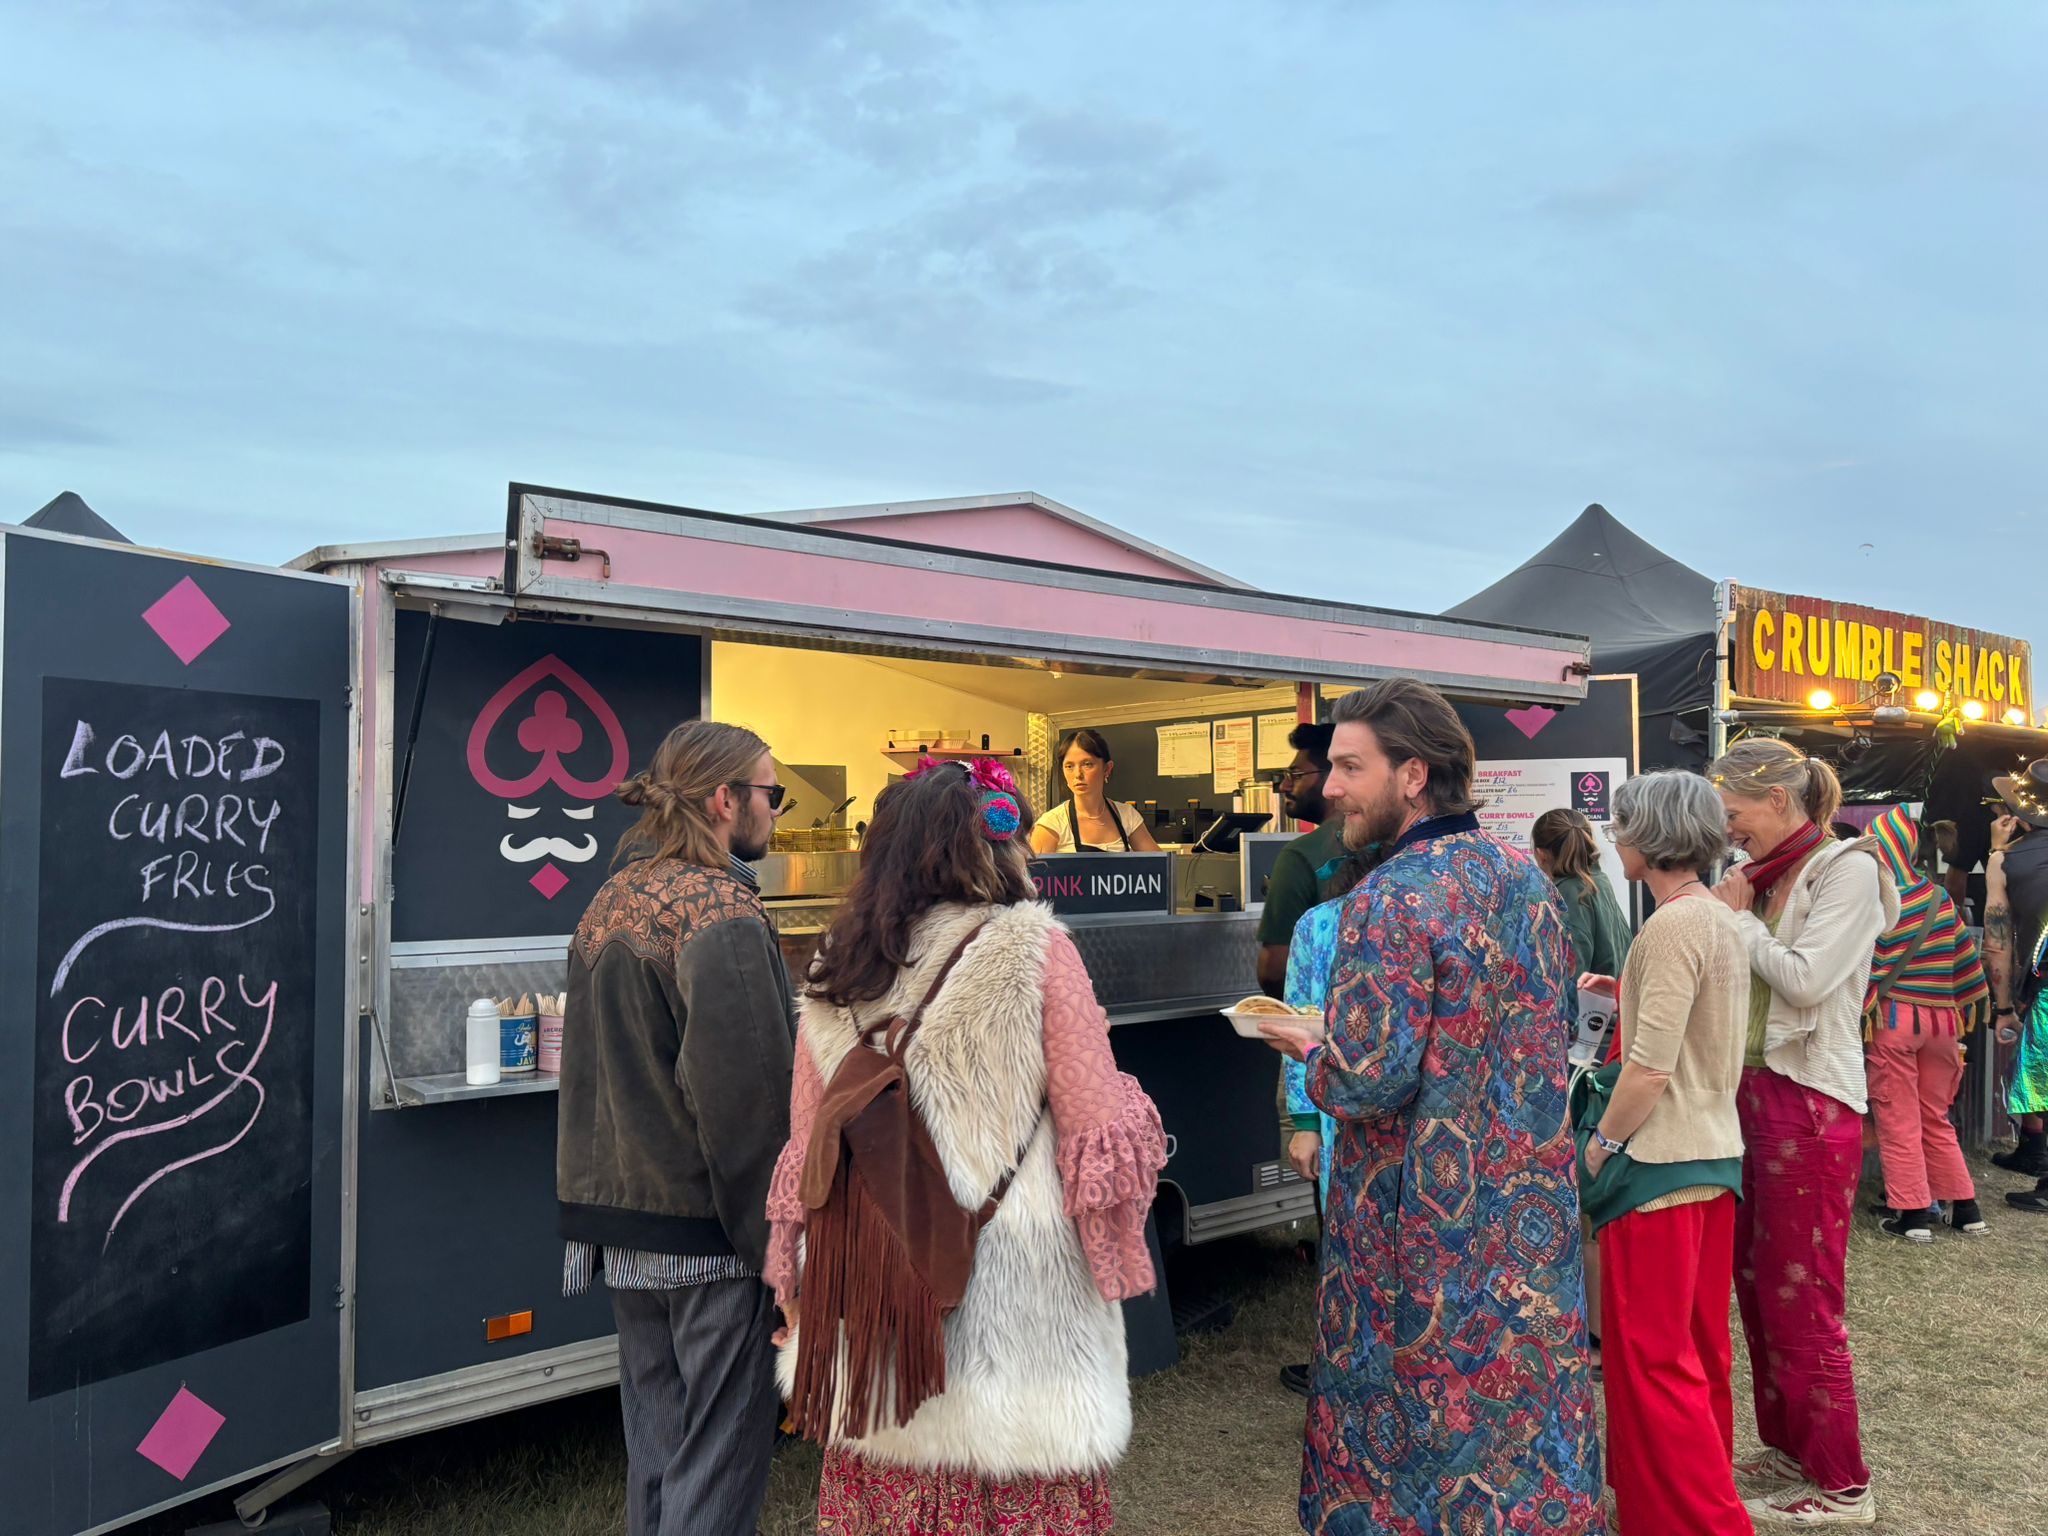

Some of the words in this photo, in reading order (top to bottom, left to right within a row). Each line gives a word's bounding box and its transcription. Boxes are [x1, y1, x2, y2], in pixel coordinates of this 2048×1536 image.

[1753, 609, 1923, 687] CRUMBLE
[1934, 639, 2024, 705] SHACK
[60, 719, 285, 780] LOADED
[109, 793, 281, 853] CURRY
[139, 850, 275, 903] FRIES
[1091, 873, 1162, 896] INDIAN
[61, 973, 279, 1066] CURRY
[66, 1040, 252, 1145] BOWLS
